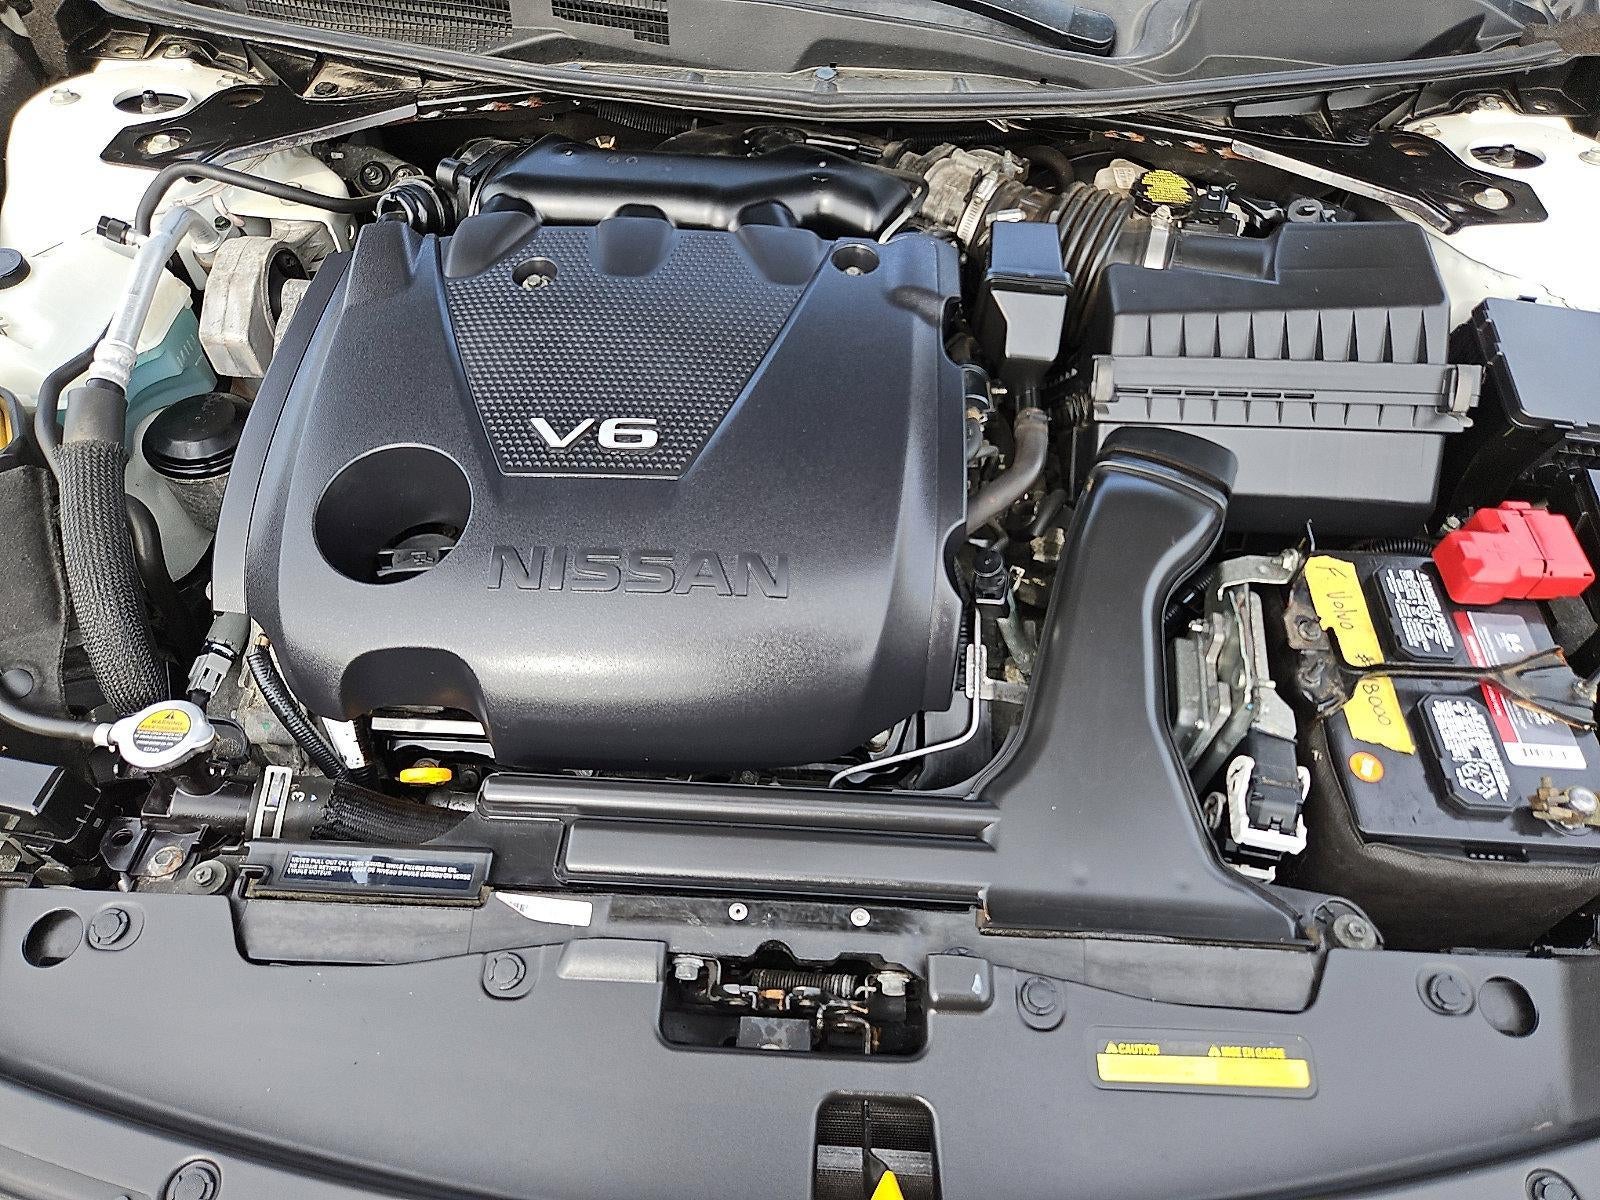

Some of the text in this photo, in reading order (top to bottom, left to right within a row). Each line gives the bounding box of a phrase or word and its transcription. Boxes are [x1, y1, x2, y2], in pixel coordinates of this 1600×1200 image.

[530, 418, 658, 449] V6
[487, 545, 790, 599] NISSAN
[1118, 1043, 1160, 1055] CAUTION
